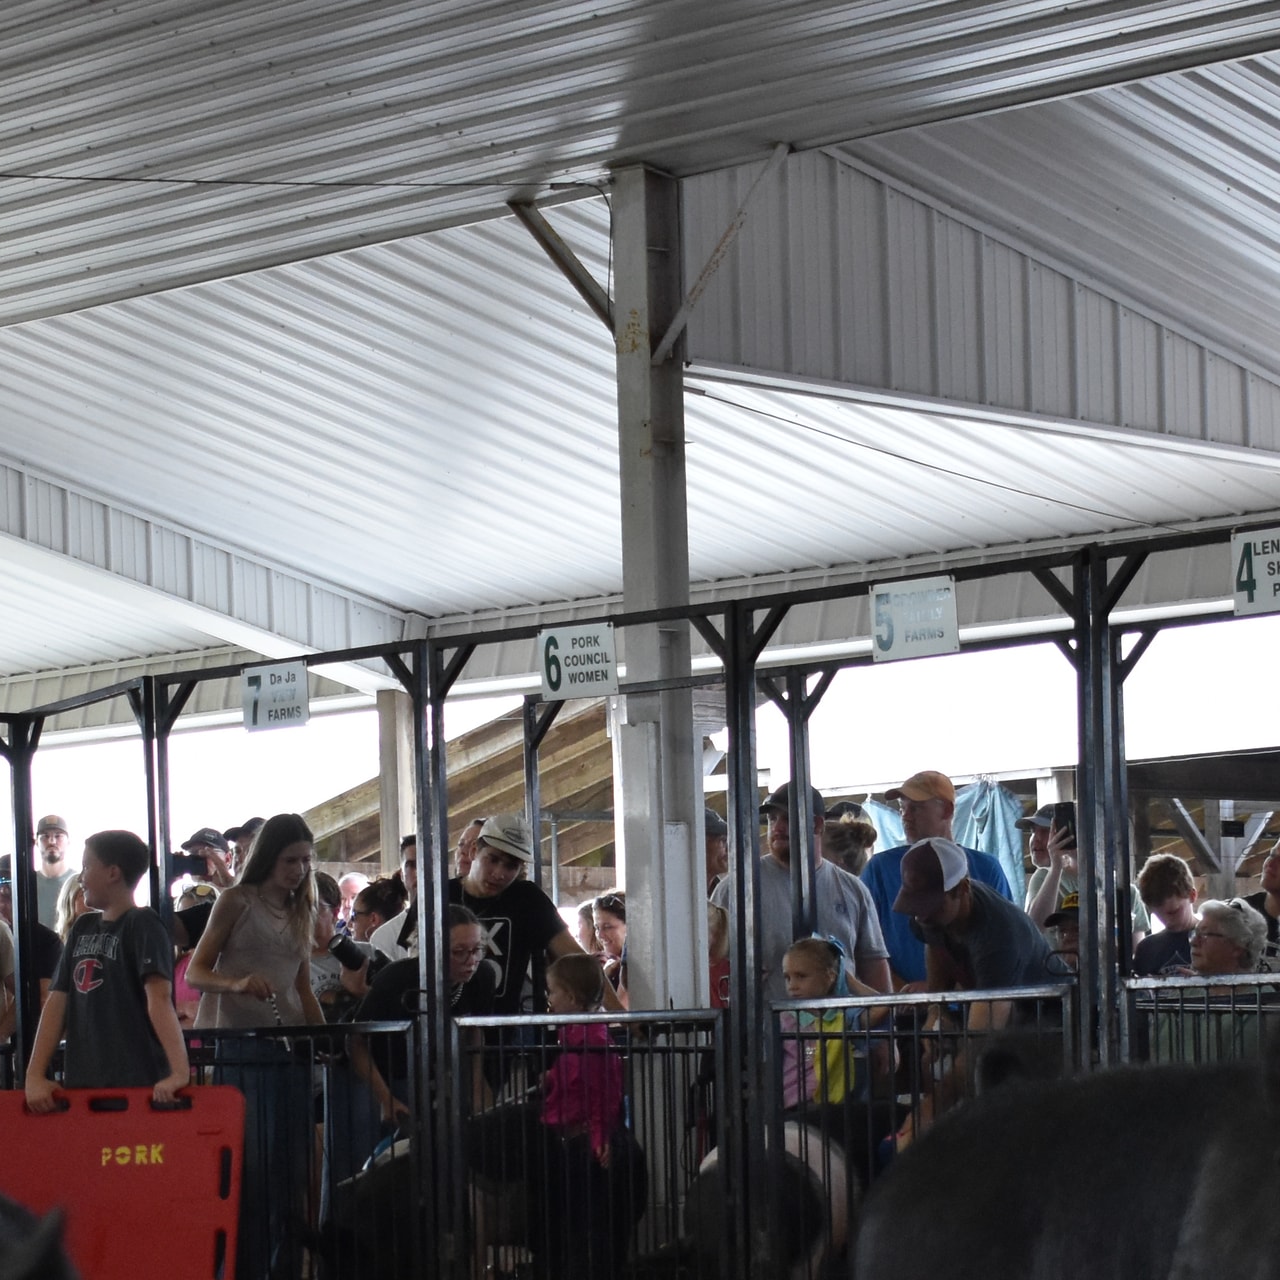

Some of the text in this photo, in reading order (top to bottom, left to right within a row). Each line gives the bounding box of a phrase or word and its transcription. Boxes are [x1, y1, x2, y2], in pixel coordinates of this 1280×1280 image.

[1236, 542, 1256, 603] 4
[875, 592, 894, 652] 5
[571, 635, 600, 649] PORK
[904, 627, 944, 643] FARMS
[544, 636, 562, 692] 6
[564, 652, 611, 667] COUNCIL
[270, 671, 296, 685] Da Ja
[568, 670, 608, 684] WOMEN
[247, 675, 261, 726] 7
[268, 705, 302, 721] FARMS
[101, 1143, 164, 1166] PORK
